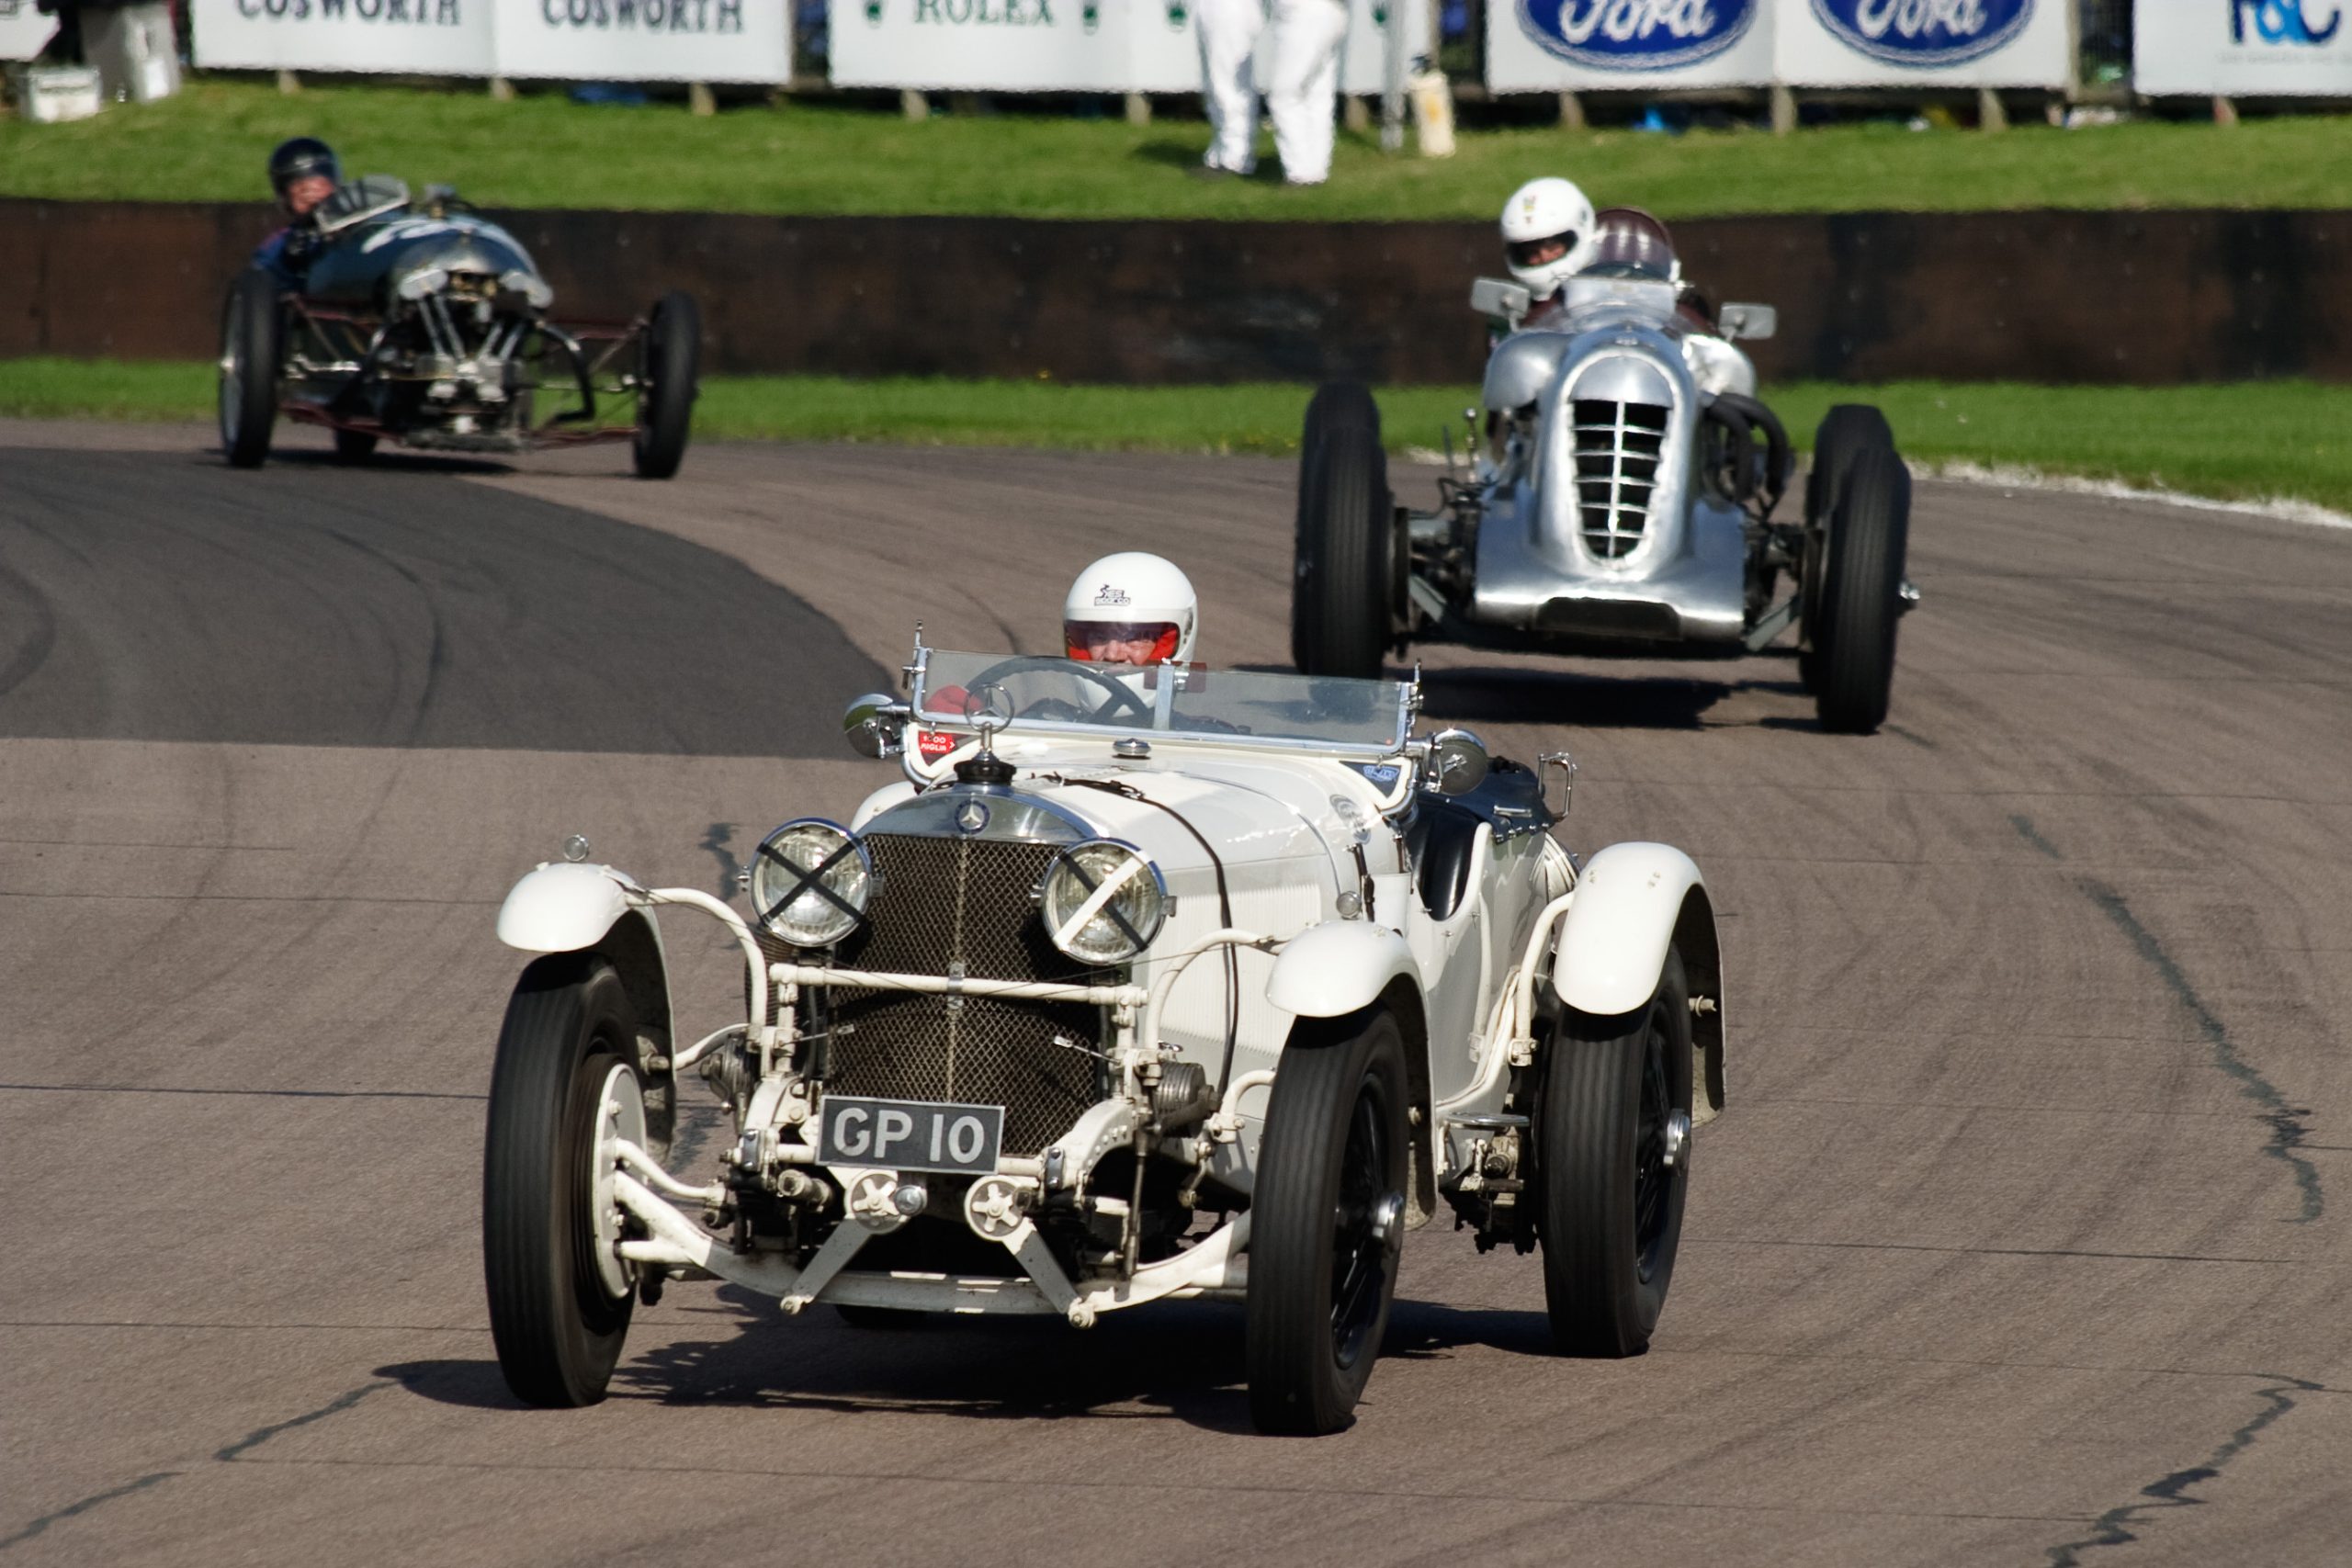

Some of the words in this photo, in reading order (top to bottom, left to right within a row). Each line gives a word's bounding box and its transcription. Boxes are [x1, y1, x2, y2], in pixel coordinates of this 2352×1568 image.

[543, 0, 742, 32] COSWORTH
[915, 0, 1056, 26] ROLEX
[1558, 0, 1717, 44] Ford
[1855, 0, 1987, 39] Ford
[833, 1107, 913, 1159] GP
[930, 1113, 985, 1164] 10
